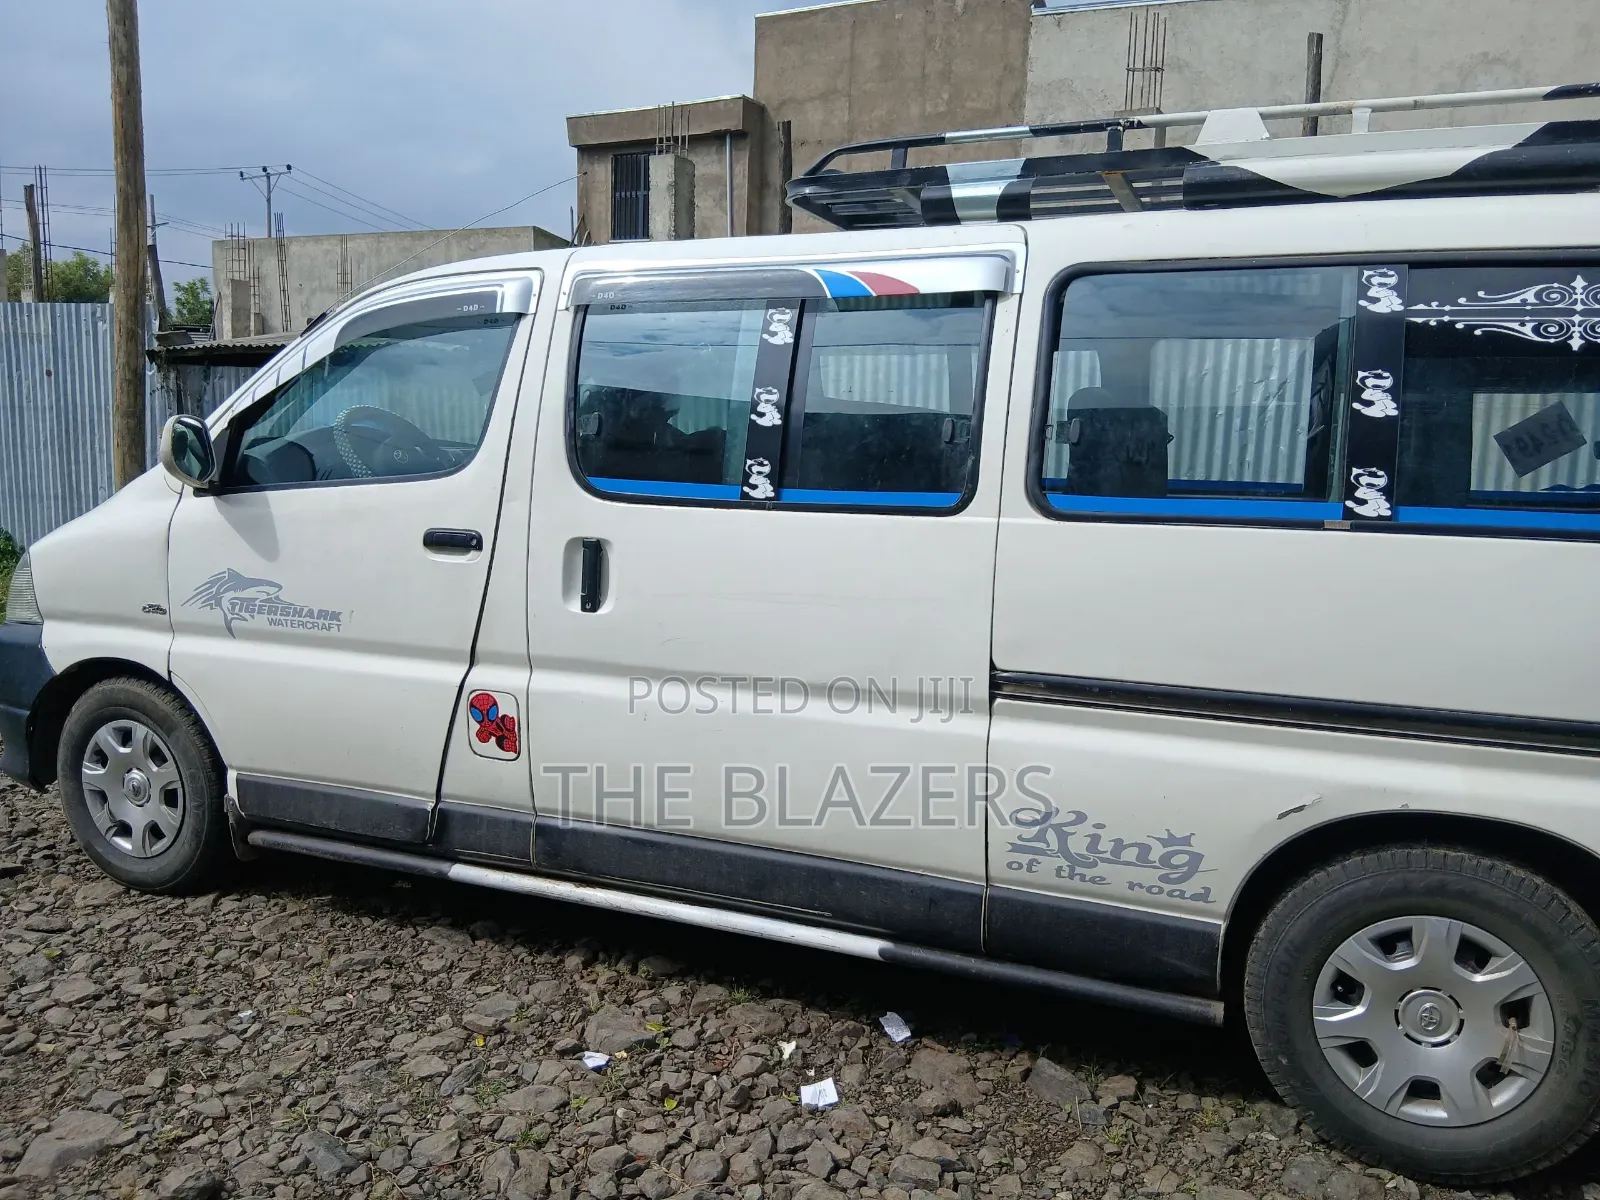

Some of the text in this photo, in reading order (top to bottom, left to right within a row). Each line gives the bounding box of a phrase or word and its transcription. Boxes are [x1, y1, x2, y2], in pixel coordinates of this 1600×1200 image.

[228, 600, 343, 622] TIGERSHARK
[267, 616, 342, 633] WATERCRAFT
[1007, 806, 1208, 885] King
[1005, 857, 1217, 904] of the road
